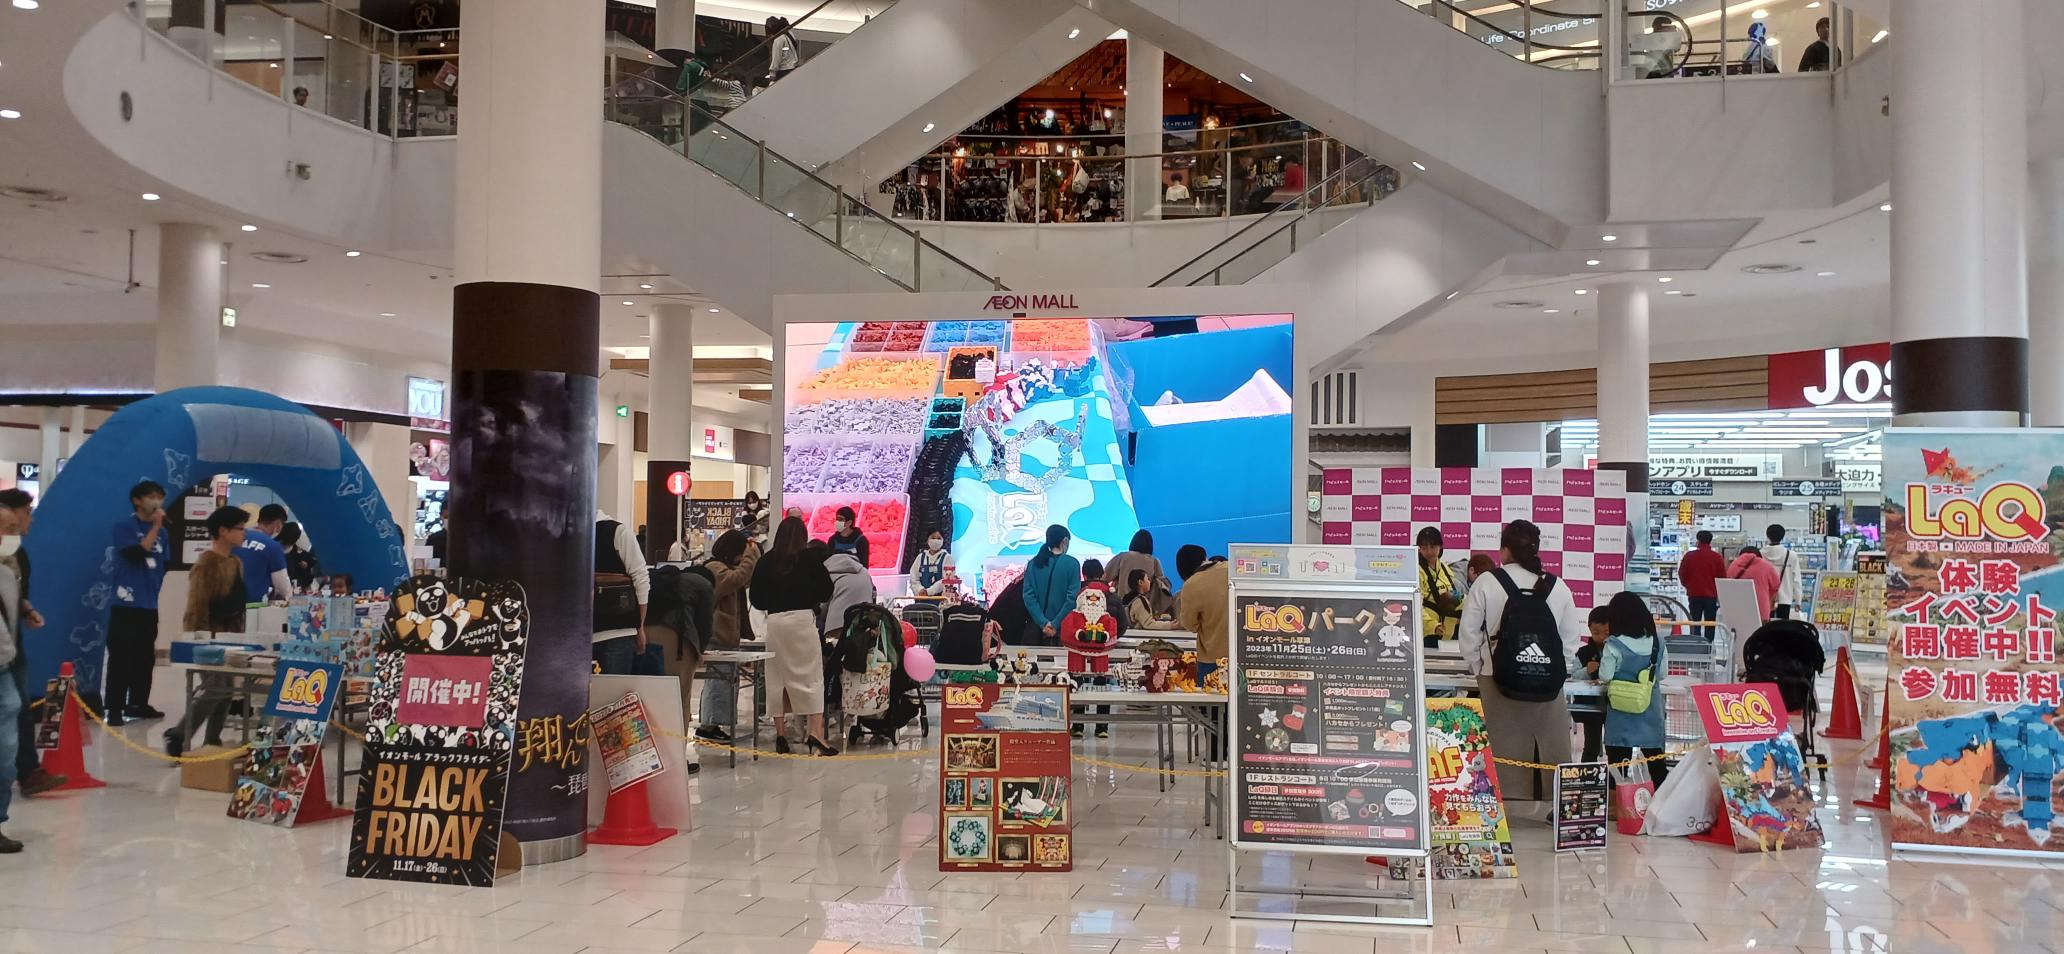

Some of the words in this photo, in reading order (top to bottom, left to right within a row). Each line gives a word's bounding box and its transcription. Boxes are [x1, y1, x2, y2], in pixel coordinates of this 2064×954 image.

[1032, 294, 1079, 309] MALL
[1803, 347, 1891, 406] Jo
[1835, 468, 1874, 481] 大迫力
[1673, 484, 1684, 492] 24
[1802, 484, 1813, 492] 25
[1931, 484, 1974, 495] ラキュー
[1905, 481, 2050, 543] LaQ
[1907, 540, 1938, 552] 日本製
[1955, 541, 1992, 553] MADE
[1994, 541, 2008, 553] IN
[2008, 541, 2050, 554] JAPAN
[1859, 561, 1882, 573] BLACK
[1938, 558, 2020, 596] 体験
[1245, 604, 1306, 633] LaQ
[1307, 607, 1376, 635] パーク
[1903, 592, 2056, 628] イベント
[1516, 655, 1551, 664] adidas
[279, 667, 330, 706] LaQ
[406, 677, 482, 704] 開催中!
[945, 686, 984, 705] LaQ
[1900, 666, 2063, 706] 参加無料
[1709, 690, 1776, 728] LaQ
[379, 751, 421, 761] イオンモール
[424, 752, 492, 764] ブラックフライデー
[373, 763, 489, 813] BLACK
[1444, 793, 1498, 806] 力作をみんなに
[366, 810, 483, 860] FRIDAY
